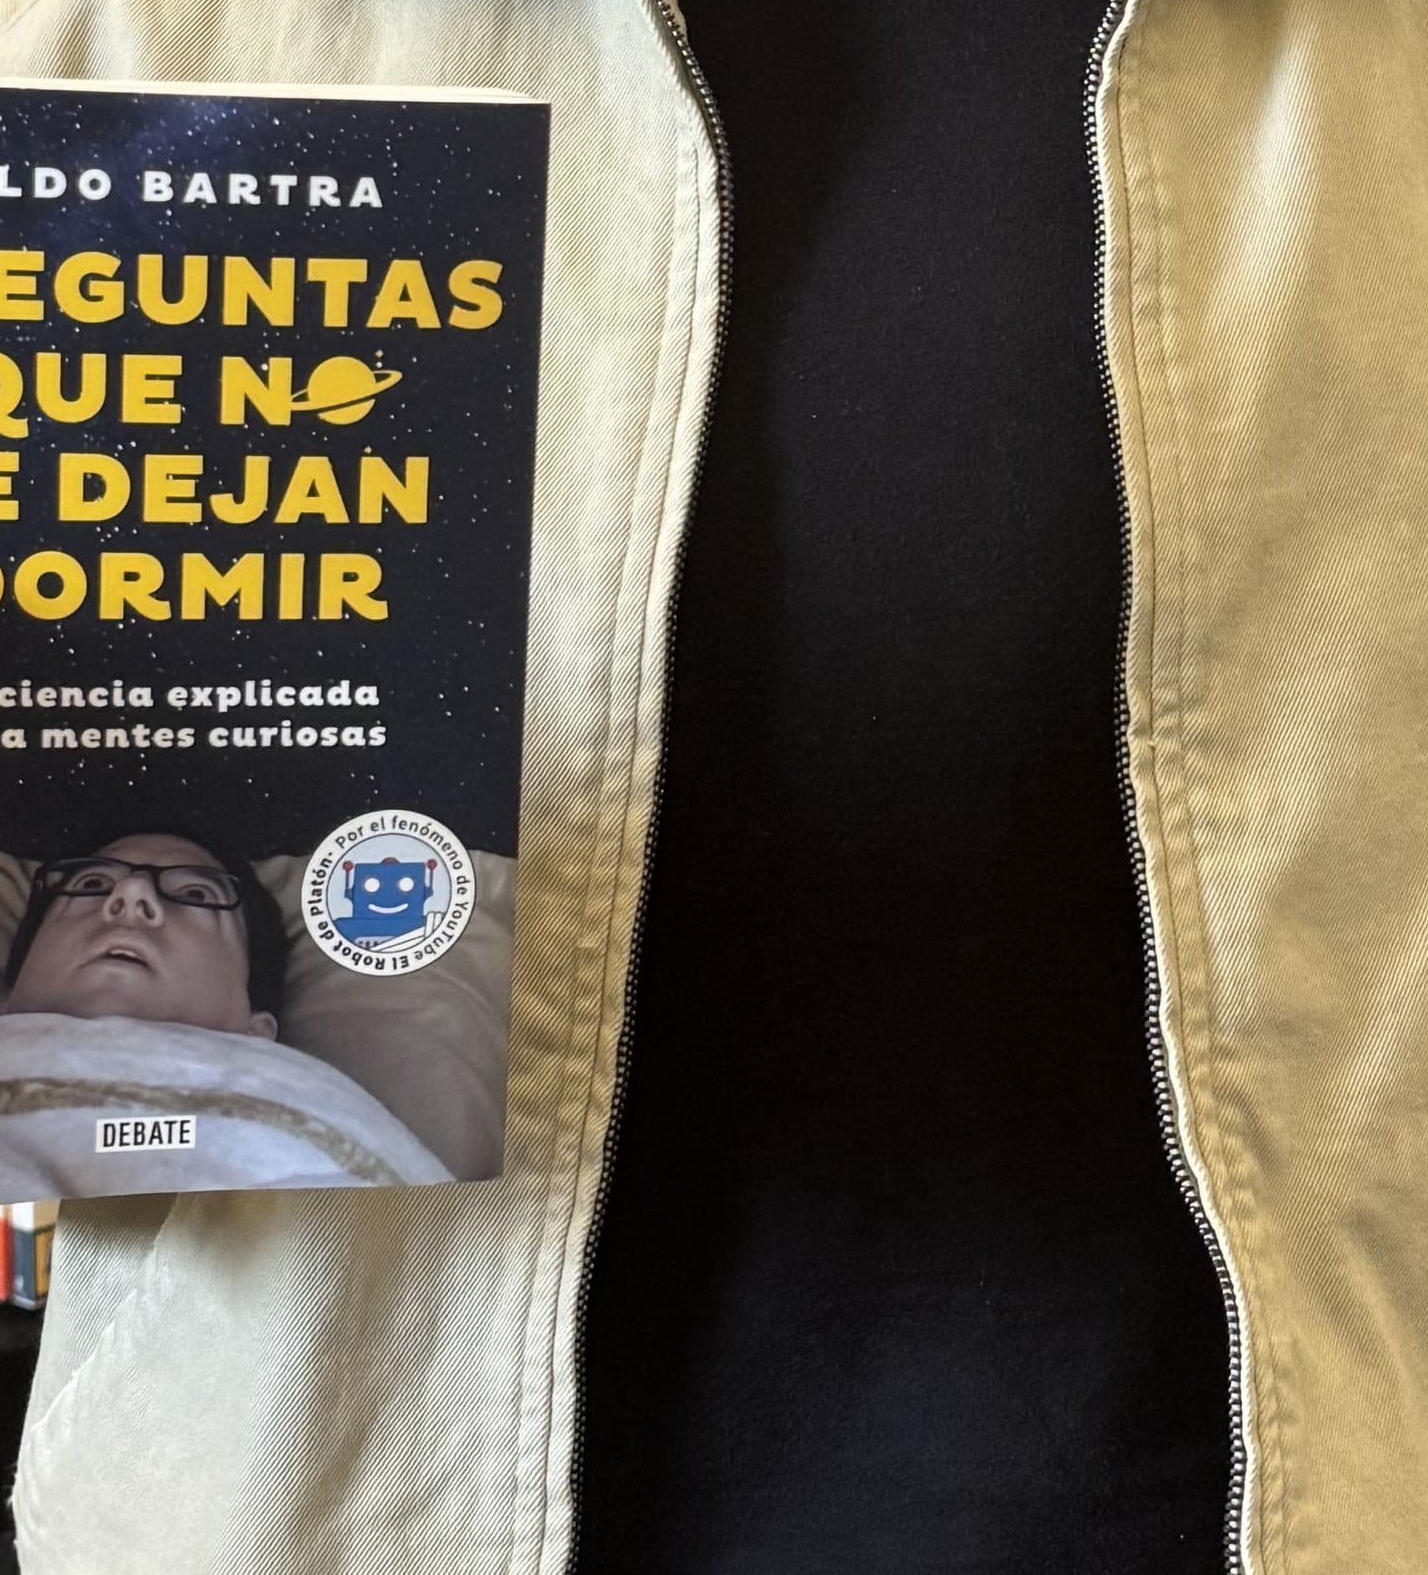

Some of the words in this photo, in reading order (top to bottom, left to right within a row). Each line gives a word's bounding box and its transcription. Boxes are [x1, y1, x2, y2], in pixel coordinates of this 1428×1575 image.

[144, 172, 383, 209] BARTRA
[58, 454, 430, 526] DEJAN
[166, 679, 381, 713] explicada
[41, 723, 196, 750] mentes
[208, 722, 388, 749] curiosas
[335, 825, 364, 849] Por
[370, 816, 385, 832] el
[391, 815, 463, 871] fenómeno
[307, 855, 333, 917] Platón
[456, 875, 471, 896] de
[317, 919, 336, 942] de
[414, 900, 470, 962] YouTube
[333, 940, 386, 971] Robot
[391, 955, 410, 970] El
[102, 1120, 192, 1149] DEBATE
